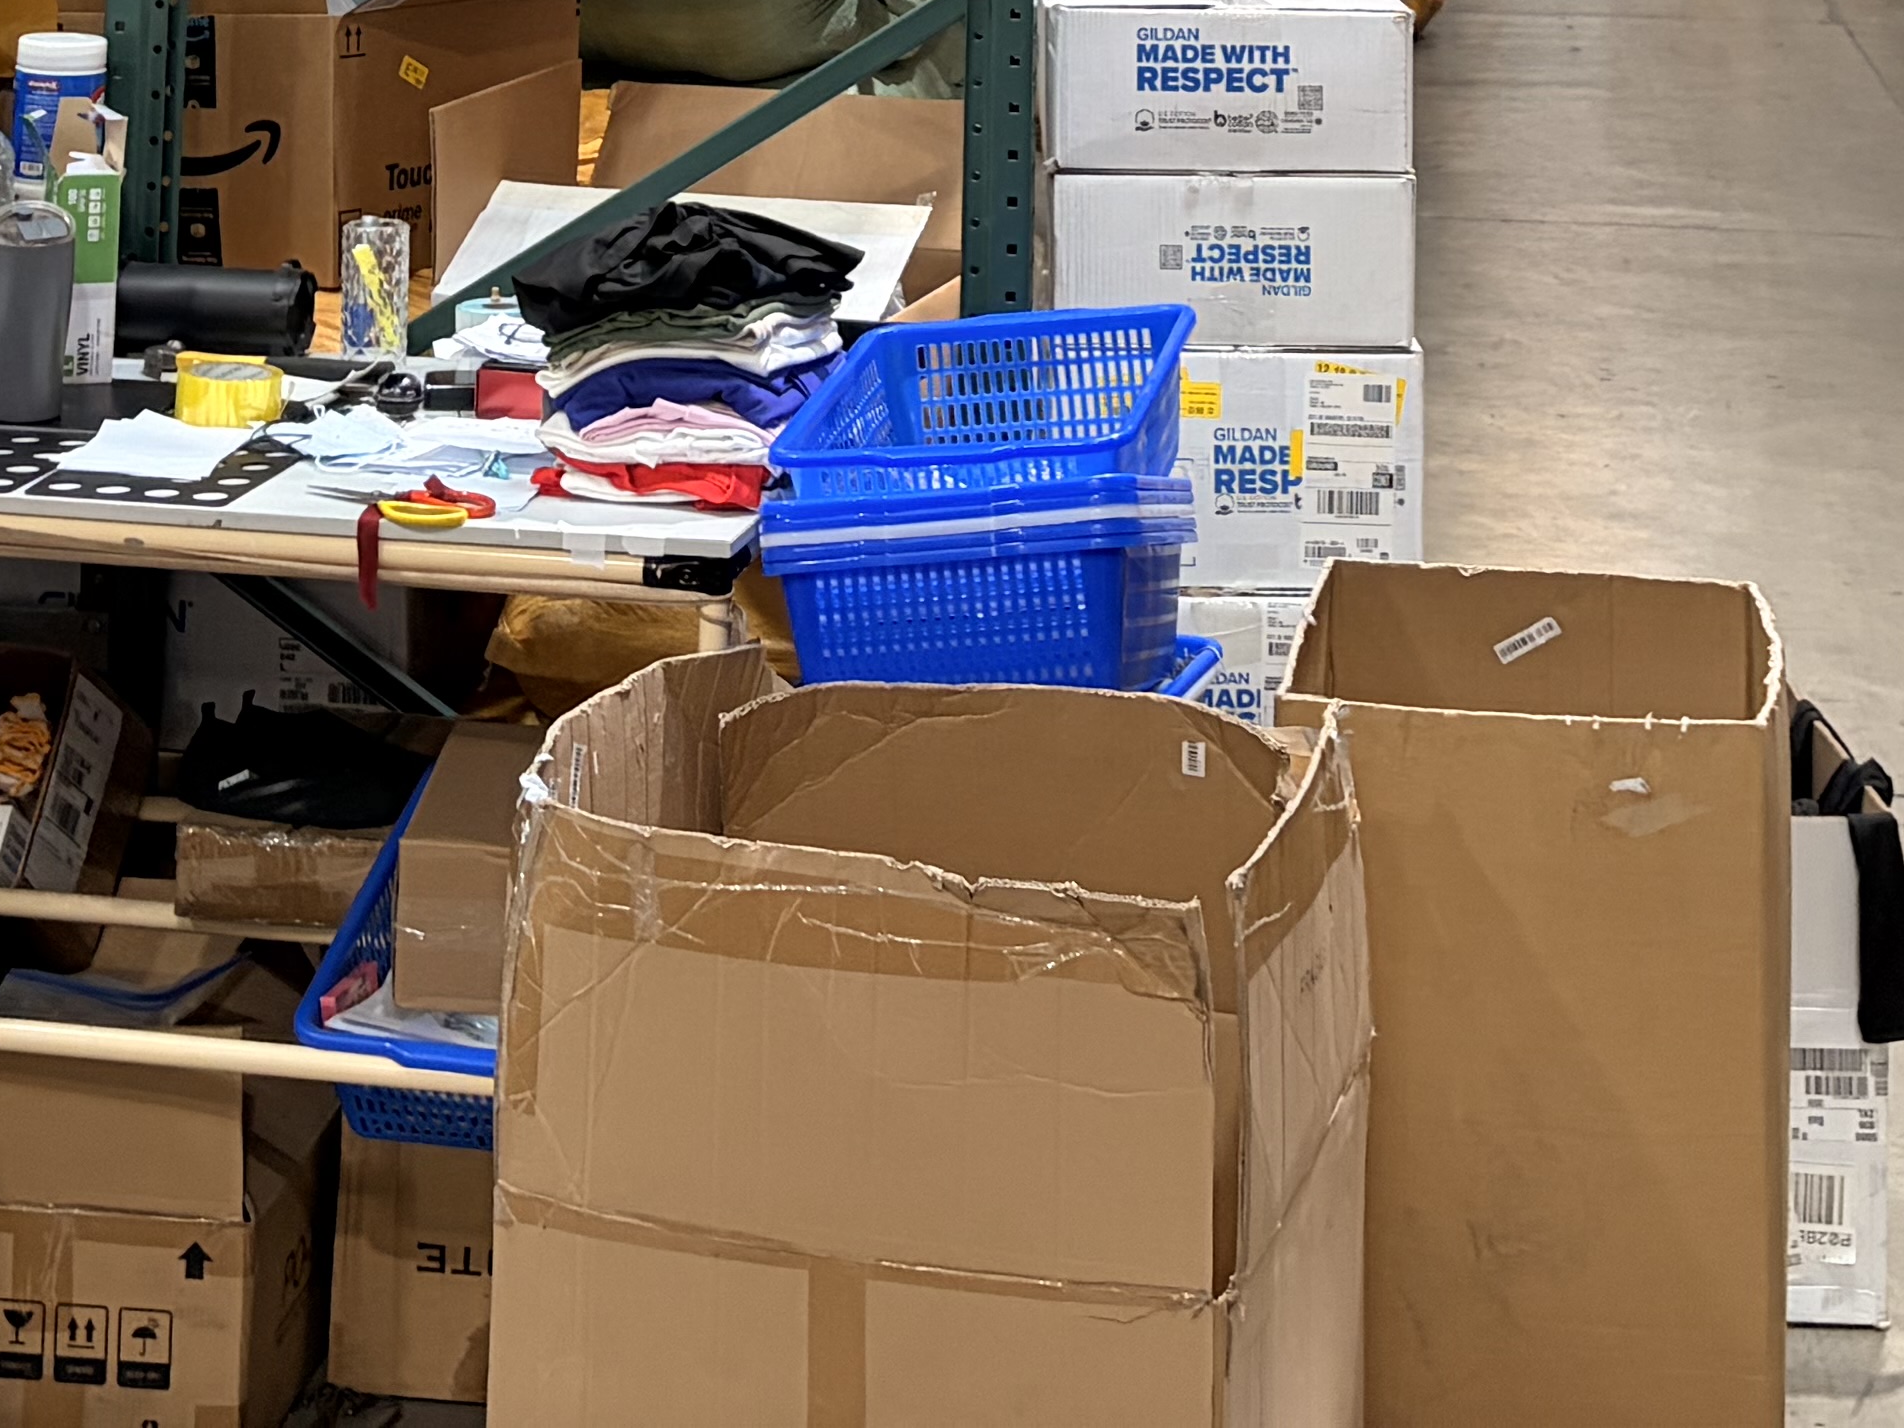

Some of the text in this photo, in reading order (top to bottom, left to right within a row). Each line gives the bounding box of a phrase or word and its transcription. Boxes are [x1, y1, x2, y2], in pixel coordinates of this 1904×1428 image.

[1136, 27, 1200, 42] GILDAN
[1135, 43, 1291, 65] MADE WITH
[1191, 243, 1311, 265] RESPECT
[1191, 266, 1311, 283] MADE WITH
[1262, 284, 1312, 297] GILDAN
[75, 333, 91, 376] VINYL
[1213, 427, 1277, 442] GILDAN
[1213, 444, 1291, 465] MADE
[1214, 468, 1303, 495] RESP
[1199, 688, 1261, 708] MAD
